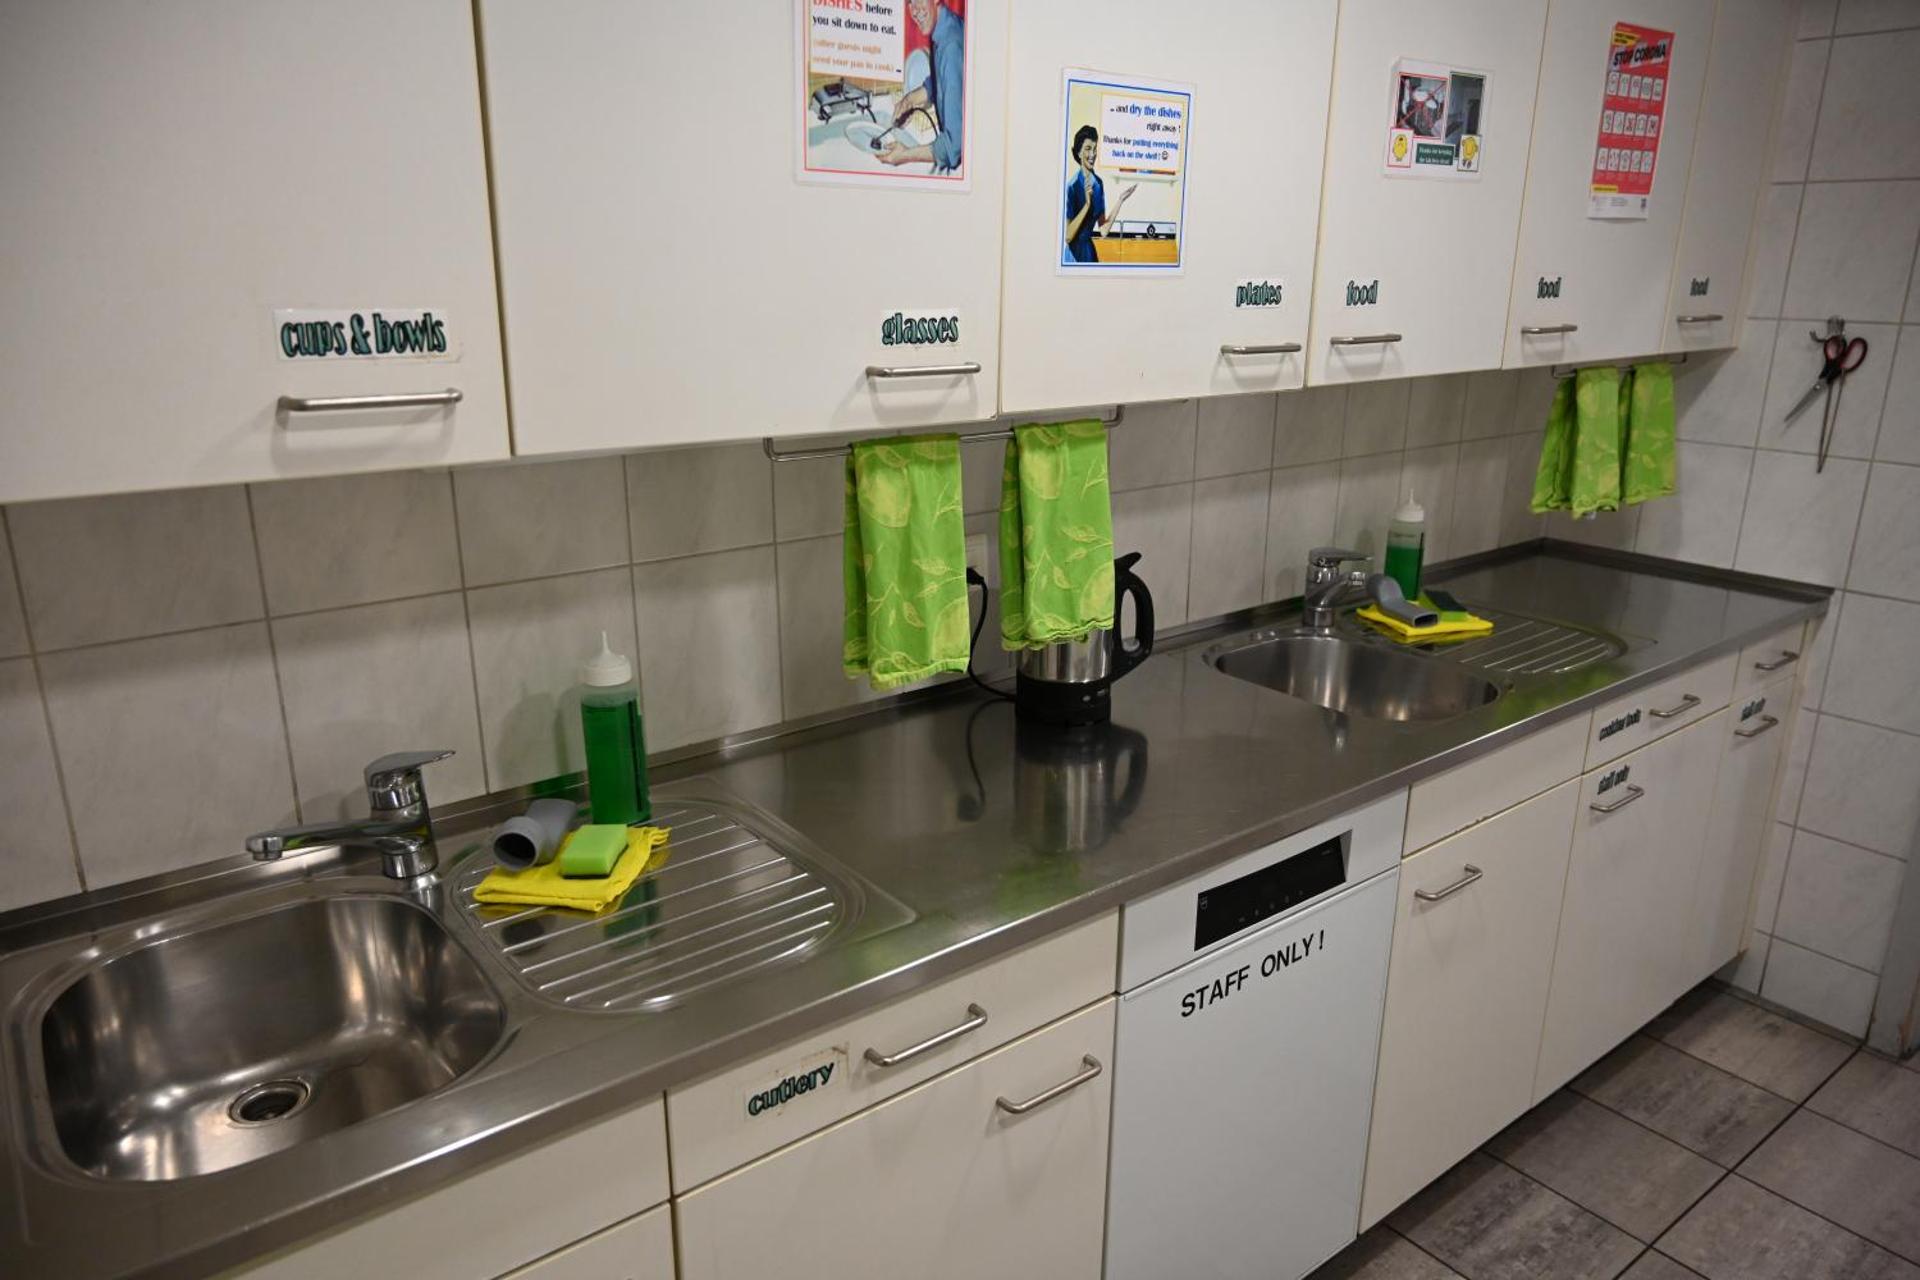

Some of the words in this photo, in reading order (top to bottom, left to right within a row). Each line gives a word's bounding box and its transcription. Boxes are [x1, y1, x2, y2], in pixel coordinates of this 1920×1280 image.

[865, 4, 893, 16] before
[812, 15, 829, 26] you
[831, 17, 842, 28] sit
[844, 18, 868, 31] down
[870, 22, 879, 33] to
[881, 25, 896, 35] eat.
[1634, 42, 1667, 63] CORONA
[1115, 104, 1129, 113] and
[1129, 103, 1142, 117] dry
[1143, 105, 1157, 116] the
[1157, 106, 1182, 119] dishes
[1103, 135, 1122, 145] Thanks
[1235, 281, 1283, 307] plates
[1346, 279, 1379, 306] food
[1537, 276, 1562, 299] food
[1690, 276, 1710, 296] food
[281, 320, 348, 357] cups
[350, 313, 372, 355] &
[372, 312, 447, 354] bowls
[881, 312, 959, 346] glasses
[1181, 965, 1250, 1018] STAFF
[748, 1062, 834, 1116] cutlery
